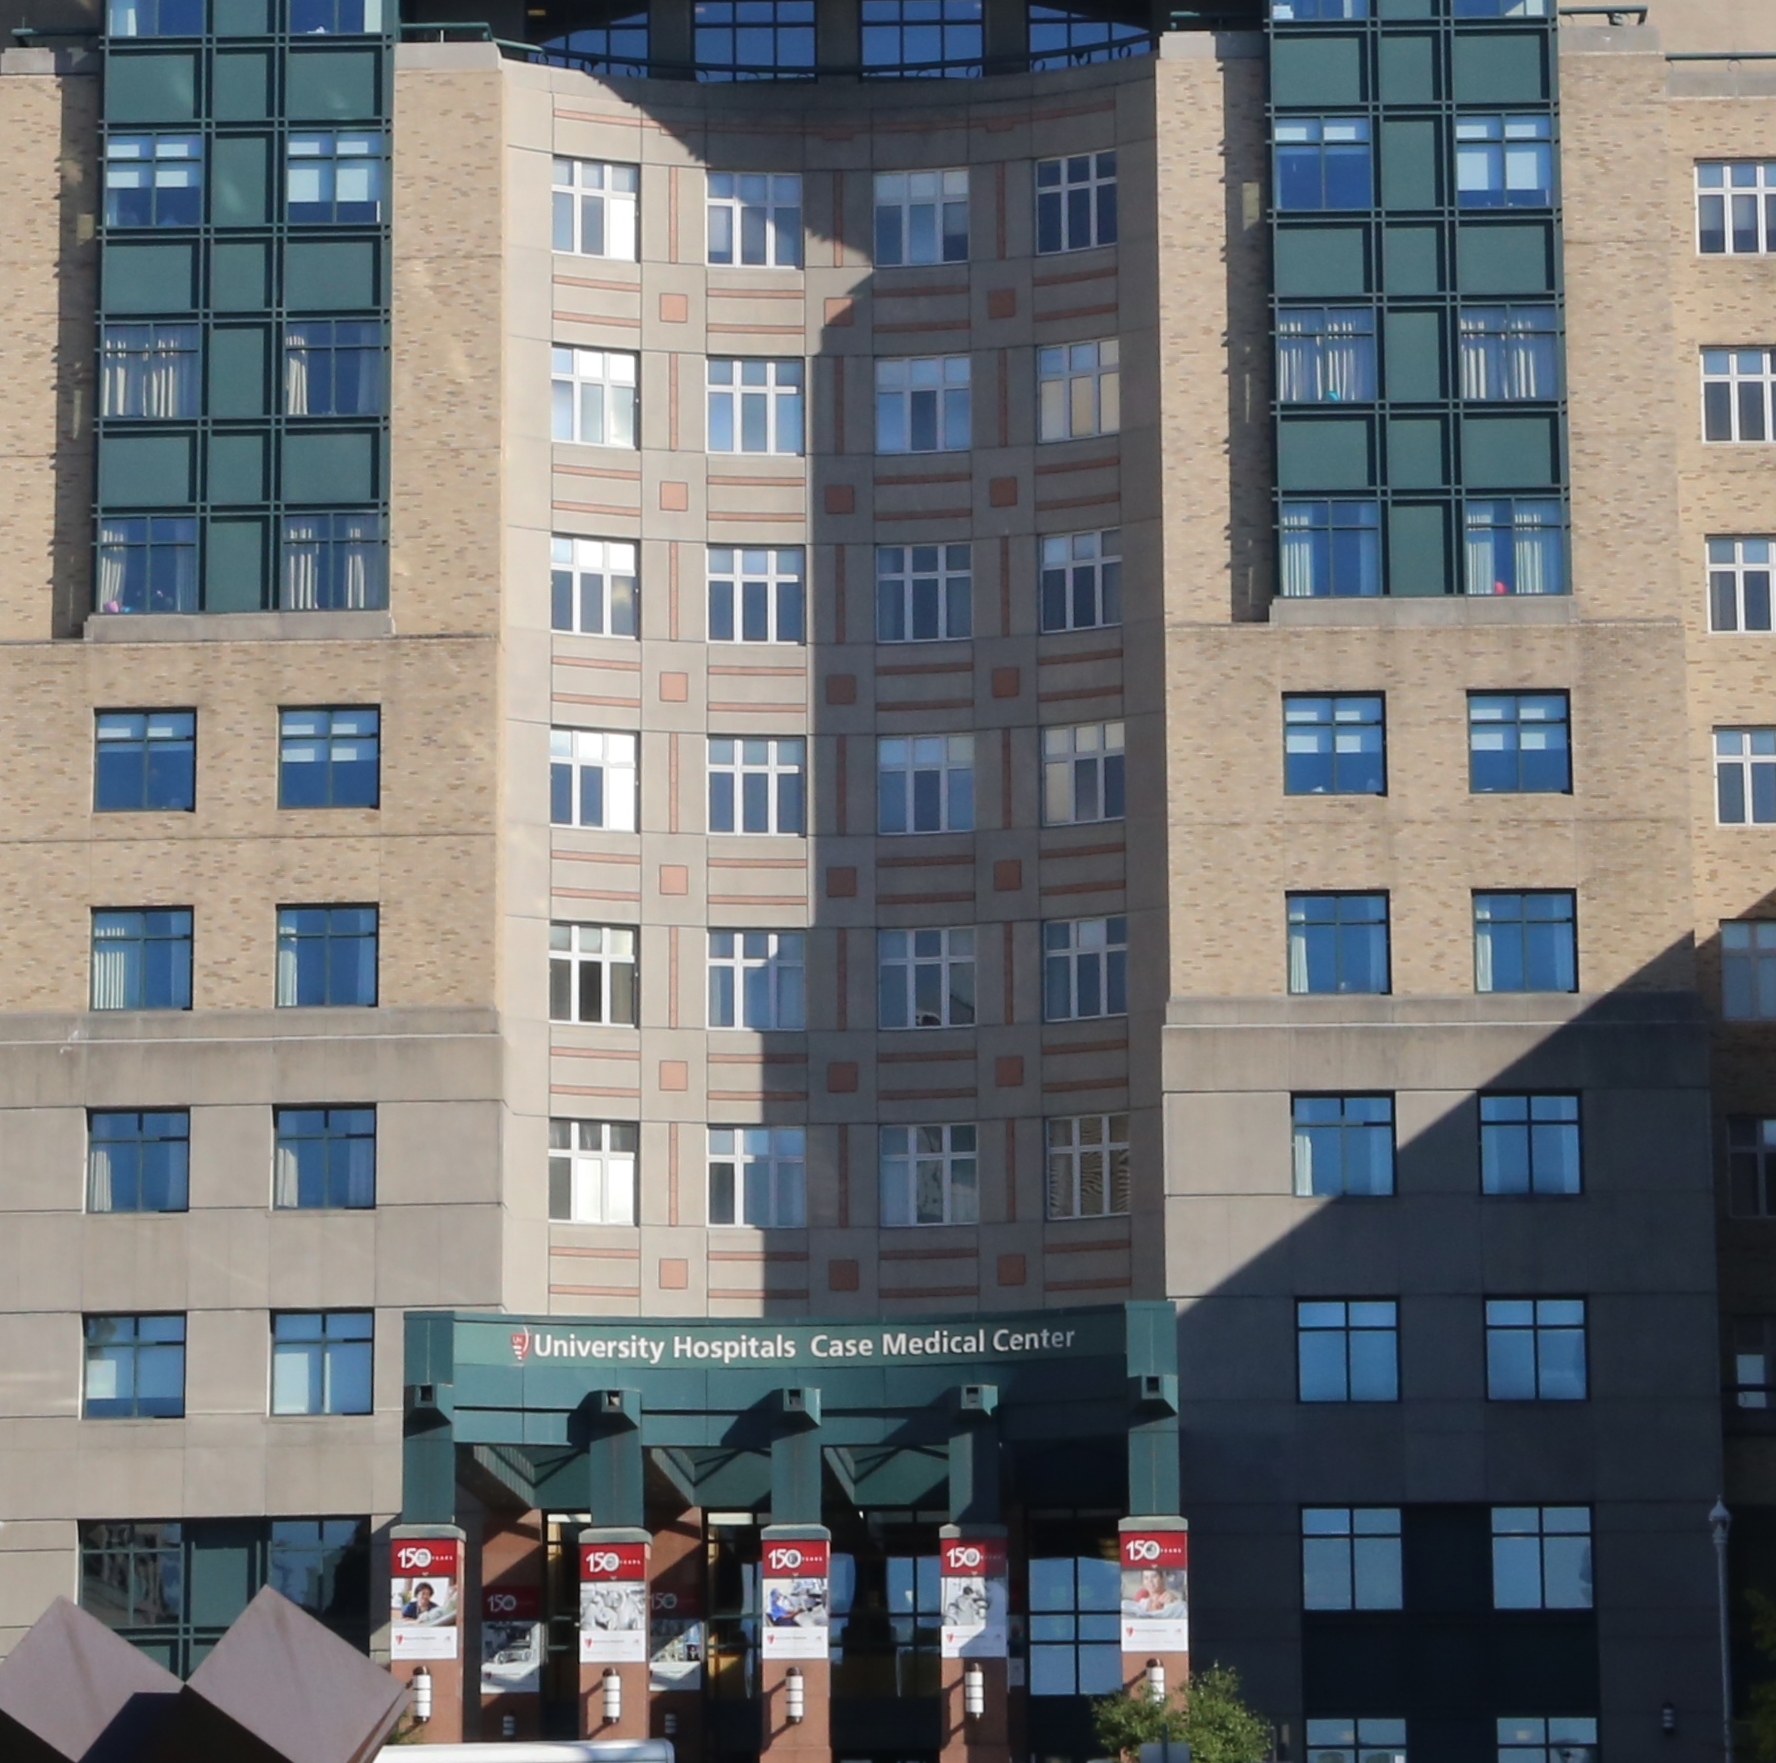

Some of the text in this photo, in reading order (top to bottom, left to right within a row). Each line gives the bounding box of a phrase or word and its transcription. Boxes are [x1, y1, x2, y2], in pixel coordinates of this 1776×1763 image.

[534, 1328, 1076, 1365] University Hospitals Case Medical Center
[397, 1547, 432, 1569] 150
[768, 1548, 802, 1570] 150
[946, 1547, 981, 1568] 150
[1126, 1540, 1161, 1561] 150
[585, 1551, 620, 1573] 150
[487, 1594, 517, 1613] 150
